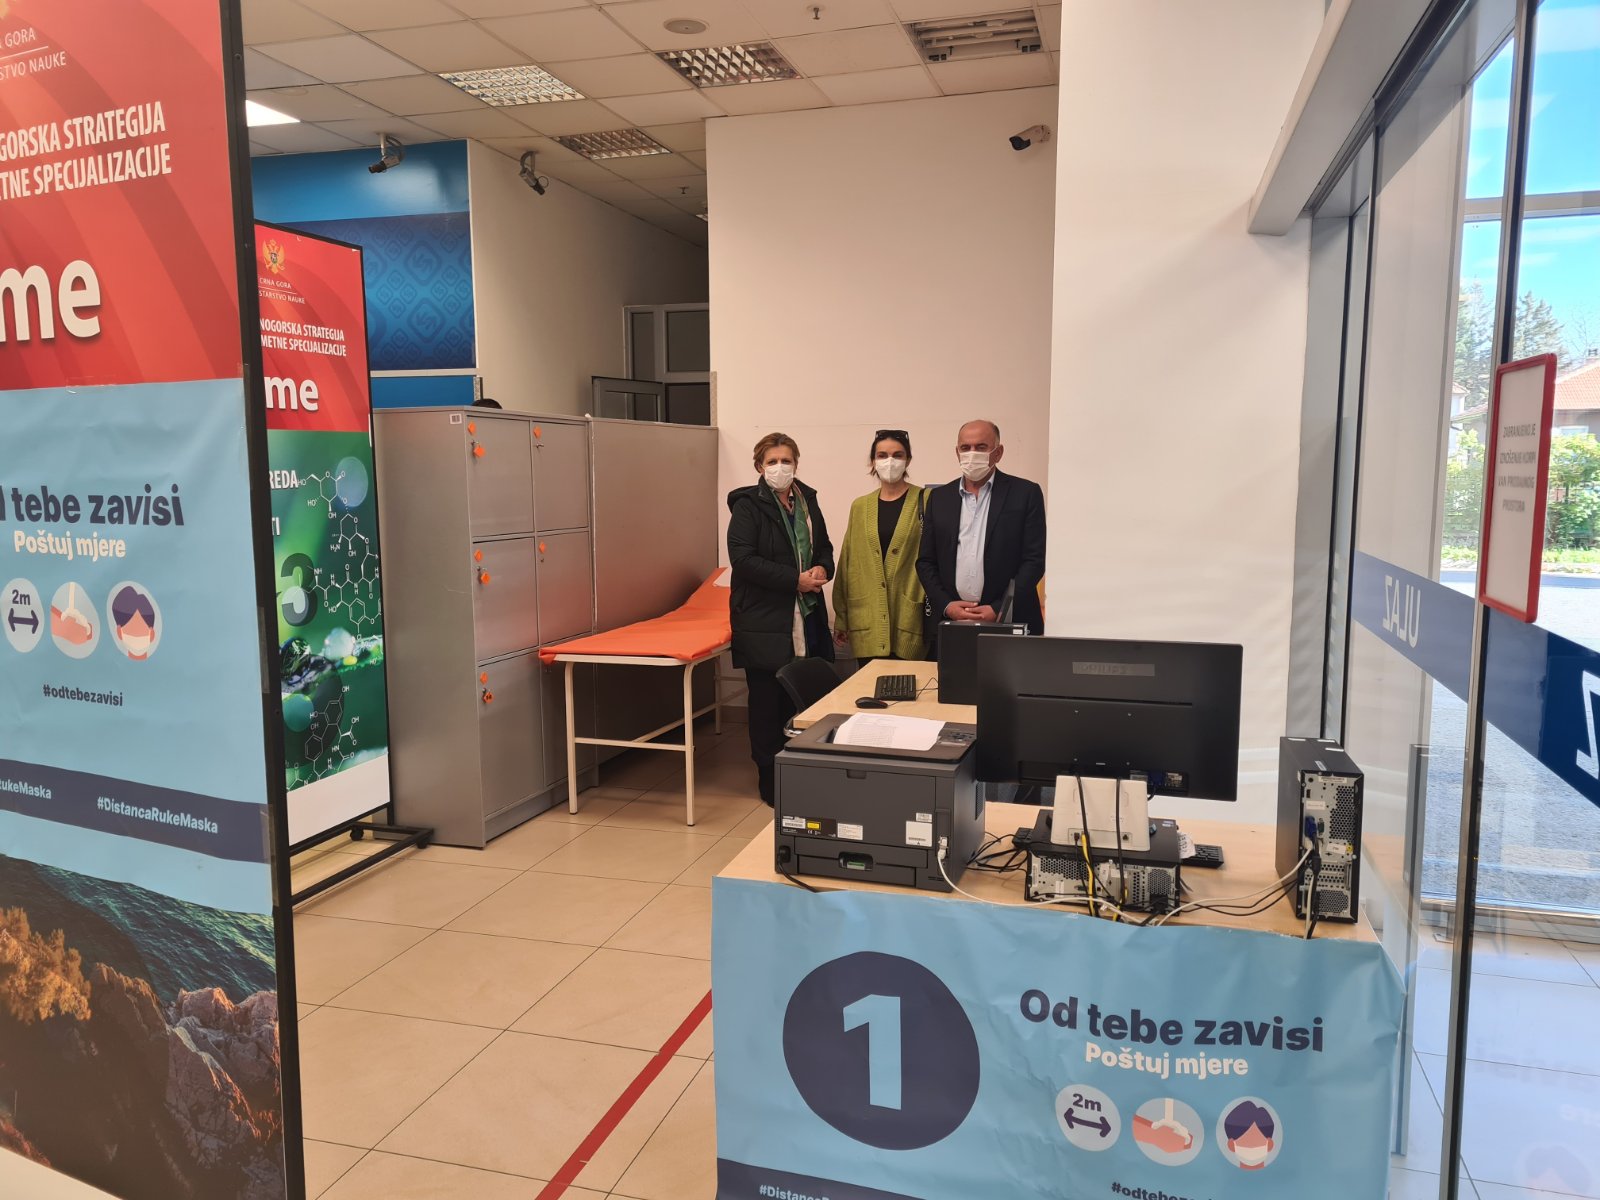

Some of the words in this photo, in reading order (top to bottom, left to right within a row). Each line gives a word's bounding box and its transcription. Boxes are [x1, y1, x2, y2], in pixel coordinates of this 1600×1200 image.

[5, 27, 36, 47] GORA
[29, 51, 66, 73] NAUKE
[0, 122, 61, 161] GORSKA
[63, 101, 165, 150] STRATEGIJA
[0, 168, 31, 200] TNE
[34, 143, 171, 194] SPECIJALIZACIJE
[260, 278, 275, 286] CRNA
[276, 280, 291, 289] GORA
[288, 295, 305, 304] NAUKE
[303, 325, 344, 341] STRATEGIJA
[289, 338, 346, 356] SPECIJALIZACIJE
[264, 376, 319, 411] me
[11, 485, 81, 524] tebe
[88, 483, 185, 526] zavisi
[14, 529, 74, 561] Poštuj
[76, 531, 127, 562] mjere
[12, 588, 32, 606] 2m
[43, 683, 124, 707] #odtebezavisi
[0, 779, 52, 800] ukeMaska
[97, 796, 218, 834] #DistancaRukeMaska
[1020, 989, 1079, 1030] Od
[1087, 1003, 1184, 1046] tebe
[1194, 1015, 1324, 1052] zavisi
[843, 994, 902, 1111] 1
[1085, 1041, 1169, 1080] Poštuj
[1175, 1052, 1249, 1080] mjere
[1072, 1093, 1102, 1112] 2m
